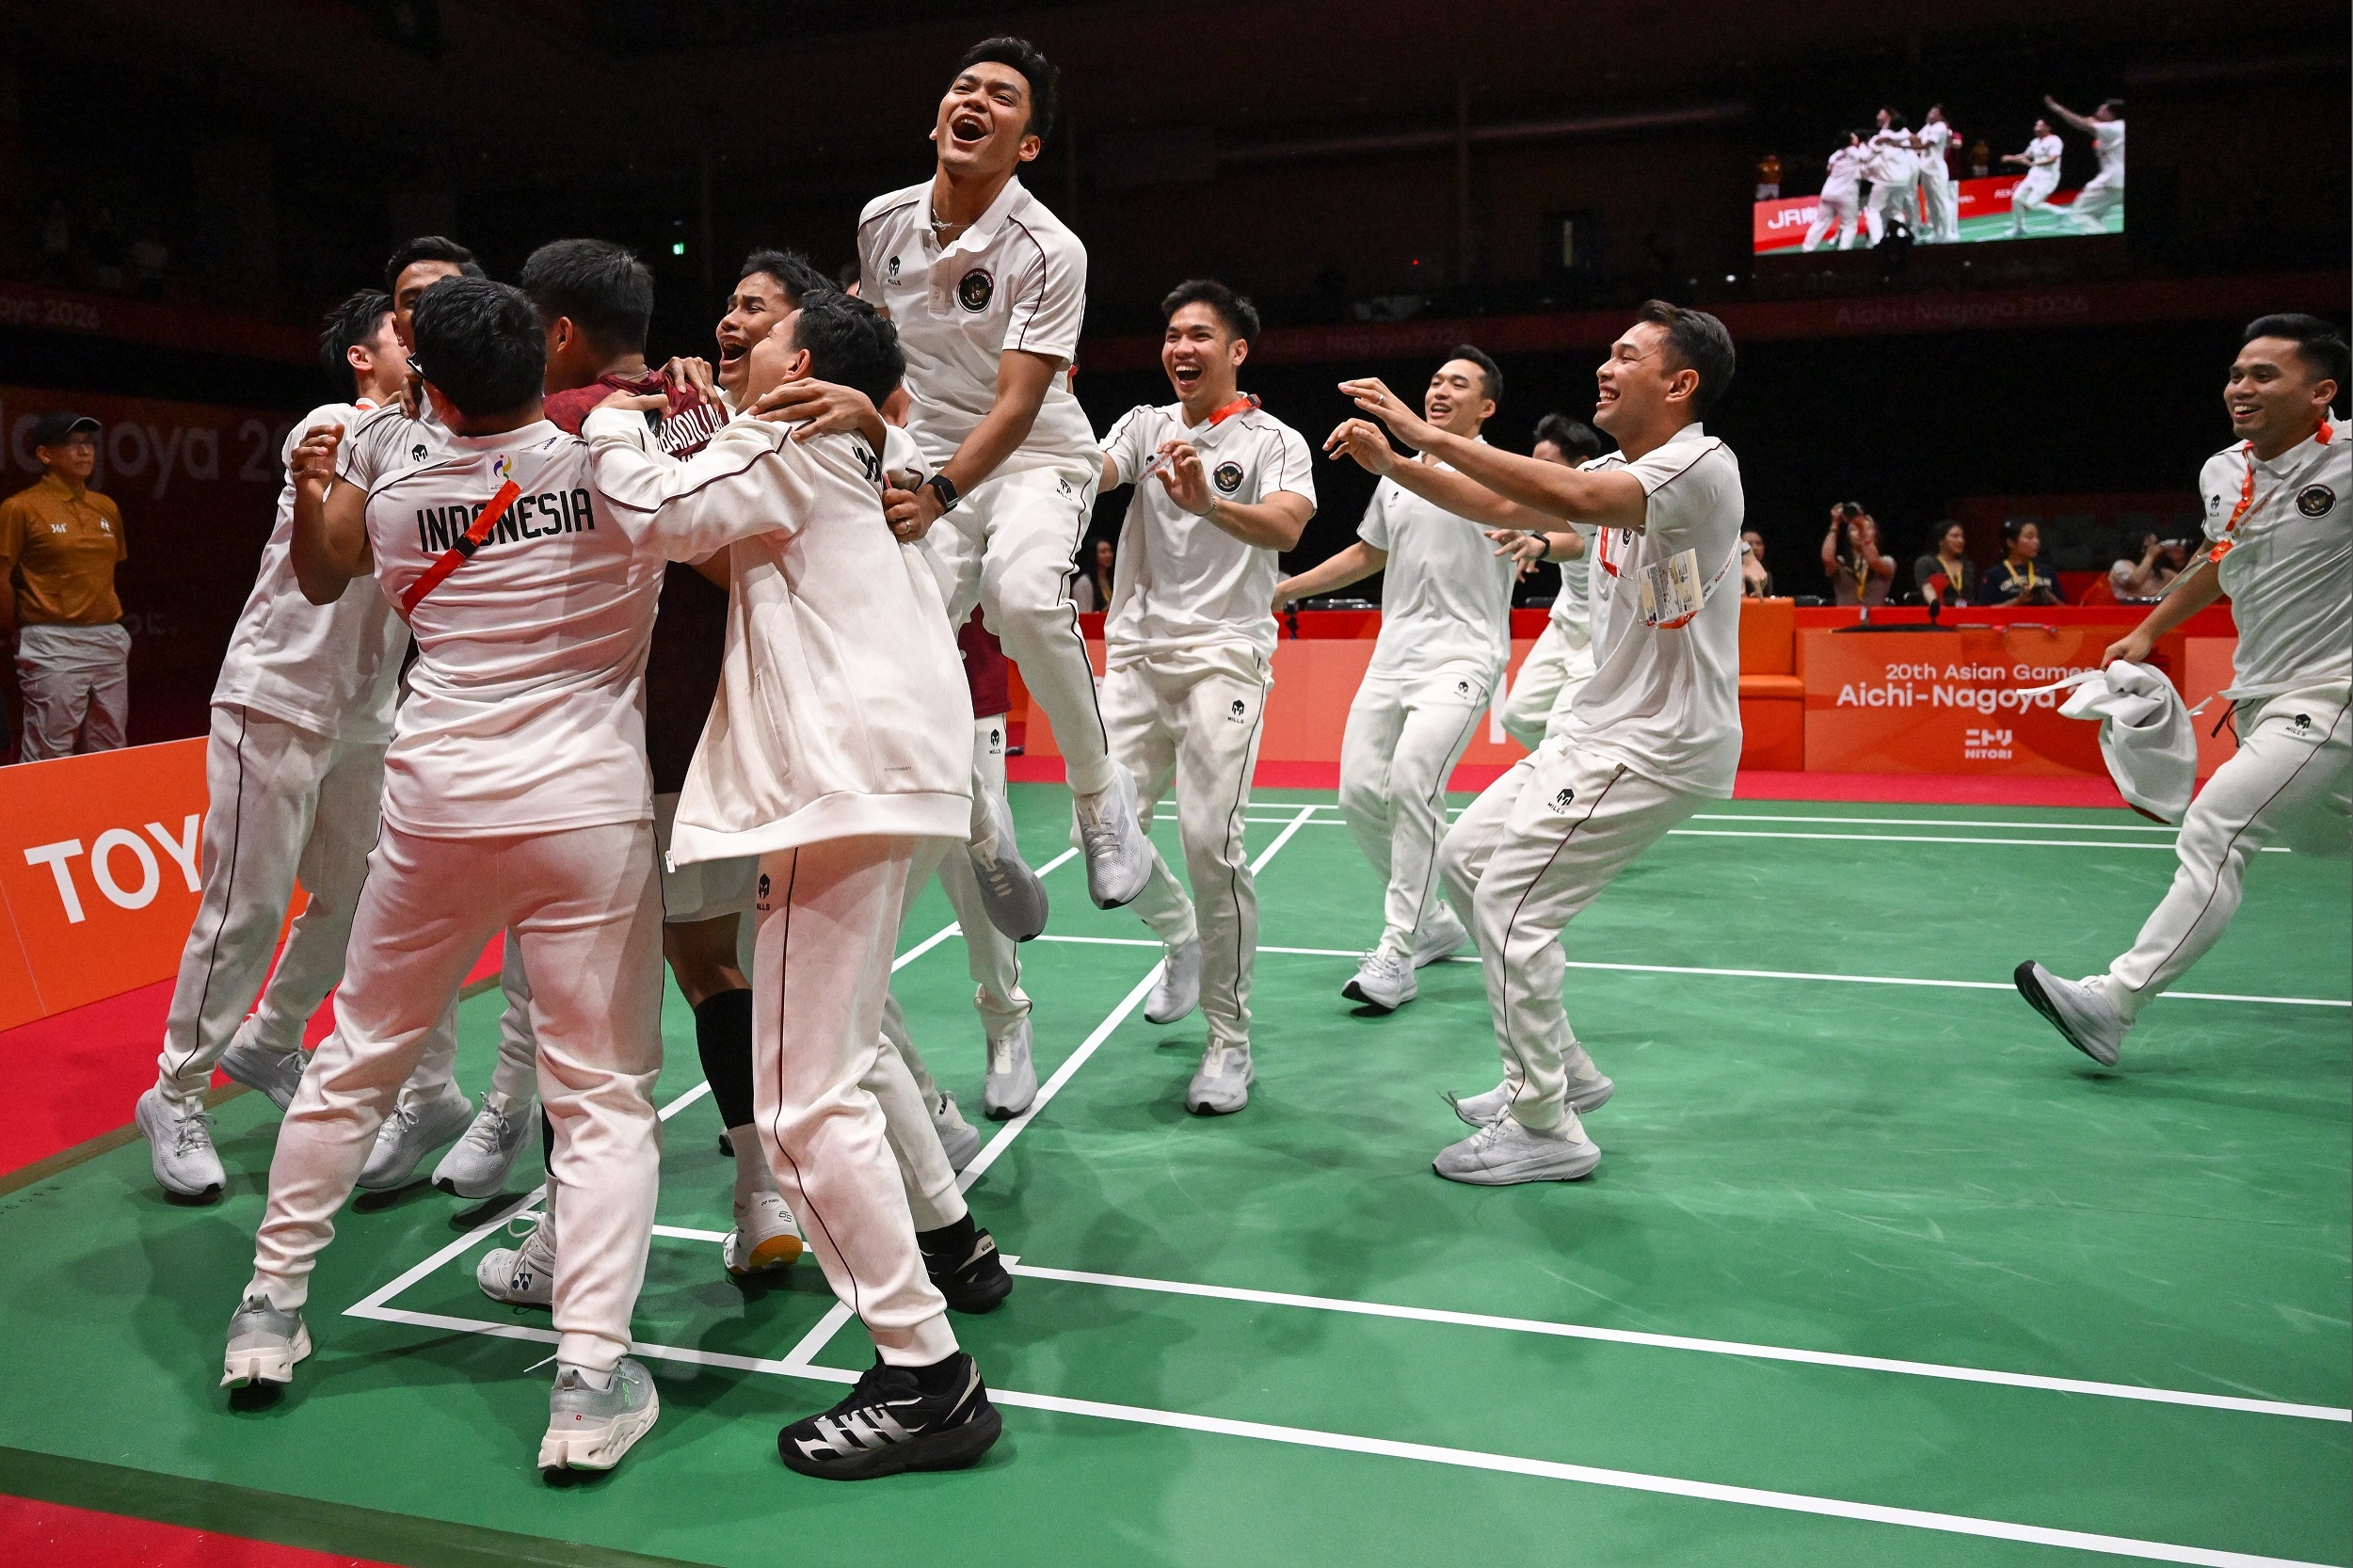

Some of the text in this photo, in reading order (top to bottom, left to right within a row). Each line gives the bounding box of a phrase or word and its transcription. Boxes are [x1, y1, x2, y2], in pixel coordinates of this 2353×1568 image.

[40, 297, 101, 329] 2026
[1885, 664, 1936, 680] 20th
[1944, 664, 2006, 680] Asian
[1836, 681, 2056, 714] Aichi-Nagoya
[1965, 728, 2012, 746] ニトリ
[1965, 749, 2012, 760] NITORI
[1547, 802, 1565, 815] MILLS
[23, 813, 201, 924] TOY
